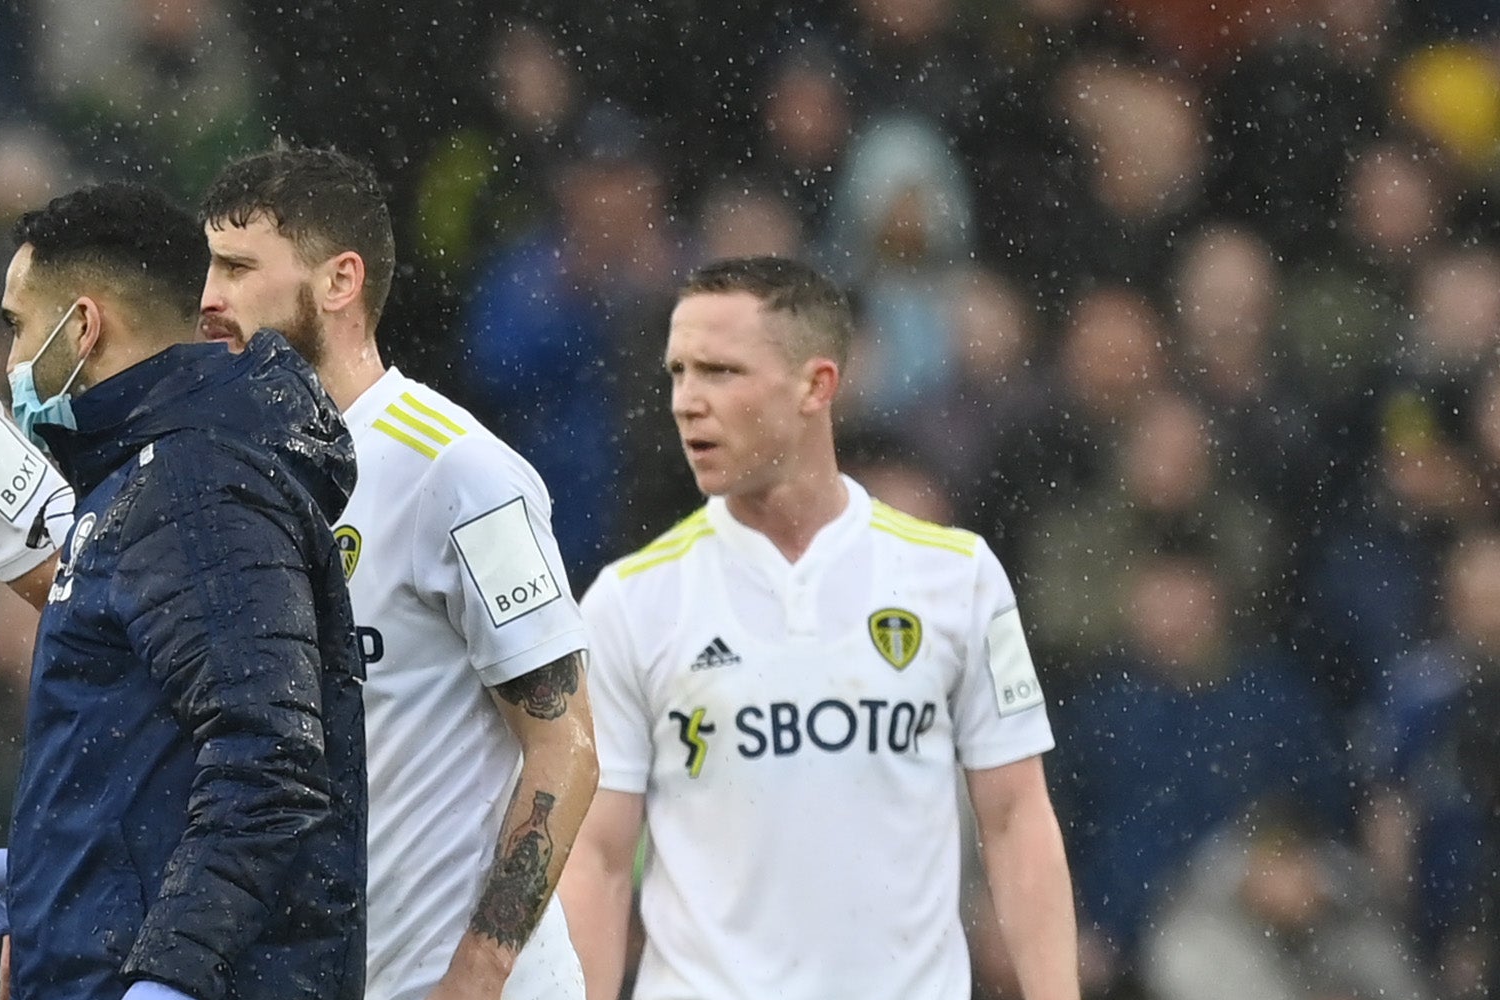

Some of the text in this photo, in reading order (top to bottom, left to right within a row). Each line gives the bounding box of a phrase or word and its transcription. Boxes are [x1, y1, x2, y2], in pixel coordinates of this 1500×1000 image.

[0, 454, 37, 505] BOXT
[495, 574, 549, 612] BOXT
[735, 699, 936, 759] SBOTOP
